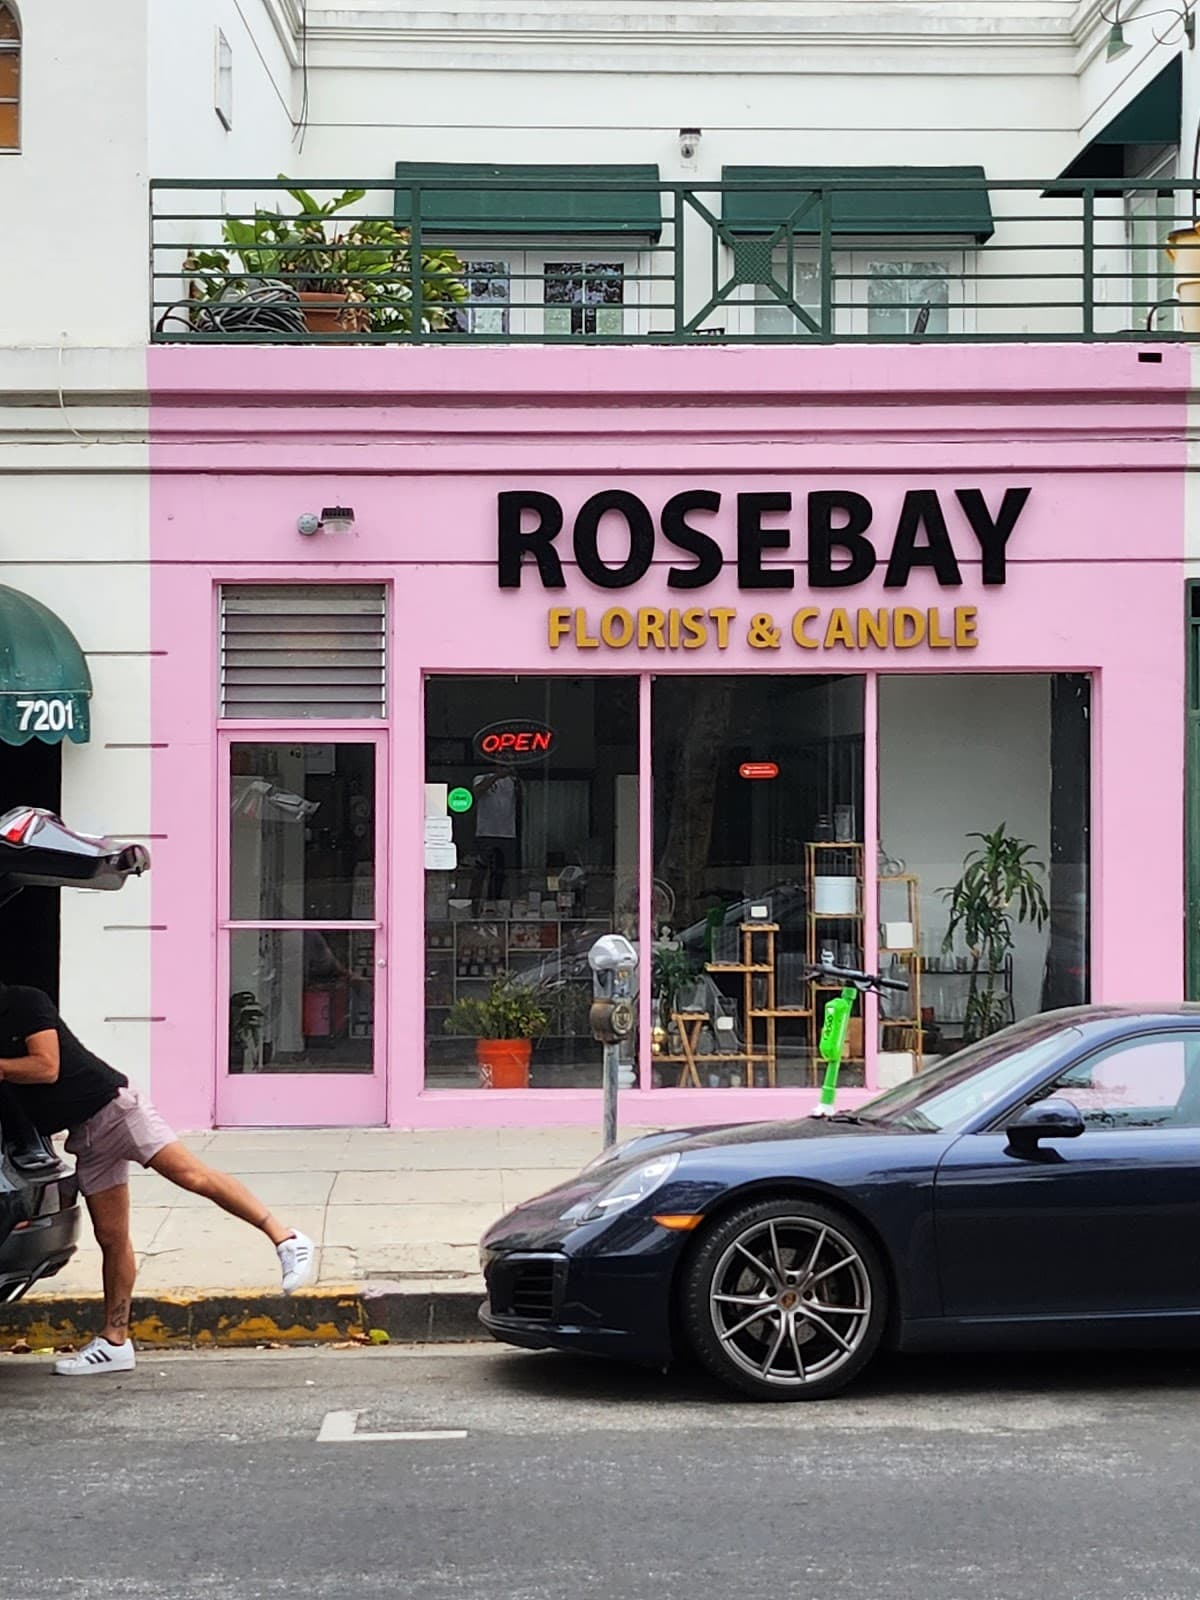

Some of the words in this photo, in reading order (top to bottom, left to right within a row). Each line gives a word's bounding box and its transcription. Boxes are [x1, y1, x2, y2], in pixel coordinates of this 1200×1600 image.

[498, 487, 1032, 590] ROSEBAY
[548, 607, 736, 651] FLORIST
[747, 613, 782, 649] &
[792, 606, 979, 650] CANDLE
[16, 699, 74, 731] 7201
[482, 731, 552, 753] OPEN
